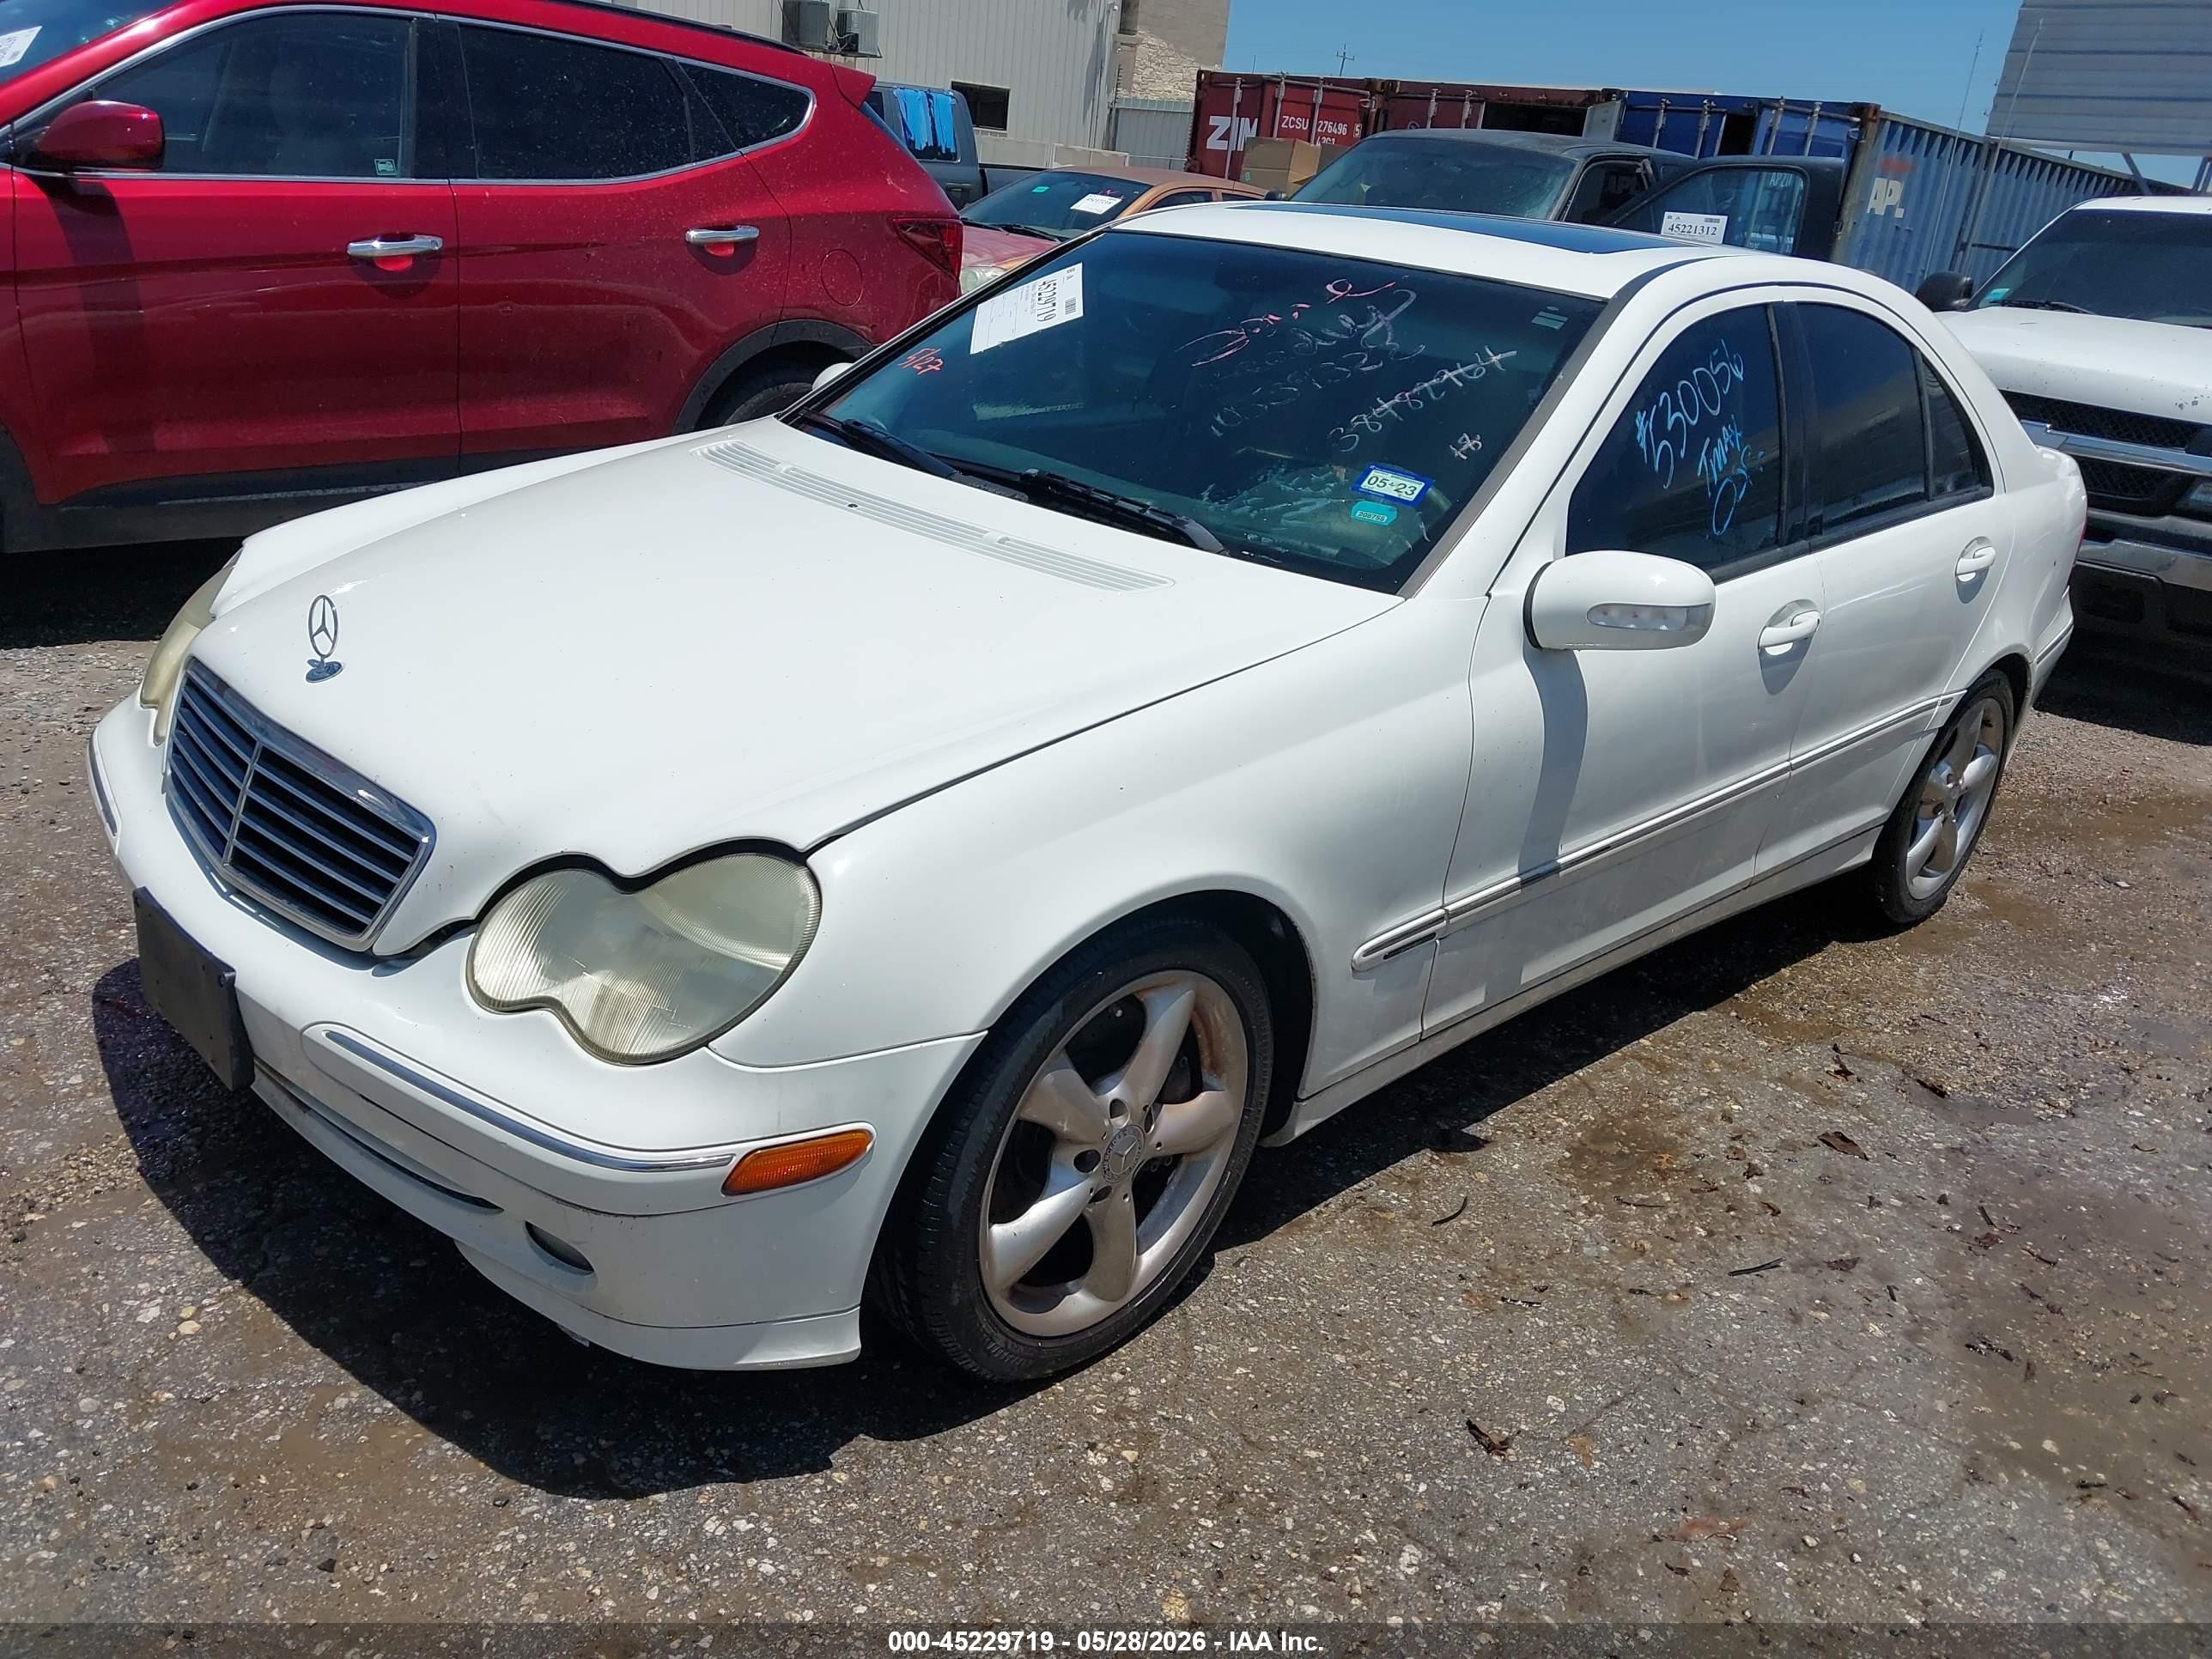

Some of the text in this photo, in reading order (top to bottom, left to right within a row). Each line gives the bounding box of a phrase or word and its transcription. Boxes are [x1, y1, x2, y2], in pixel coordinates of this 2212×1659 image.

[1206, 115, 1259, 151] ZIM
[1281, 115, 1310, 131] ZCSU
[1317, 120, 1347, 137] 276496
[1668, 222, 1717, 236] 45221312
[1036, 278, 1057, 322] 45229719
